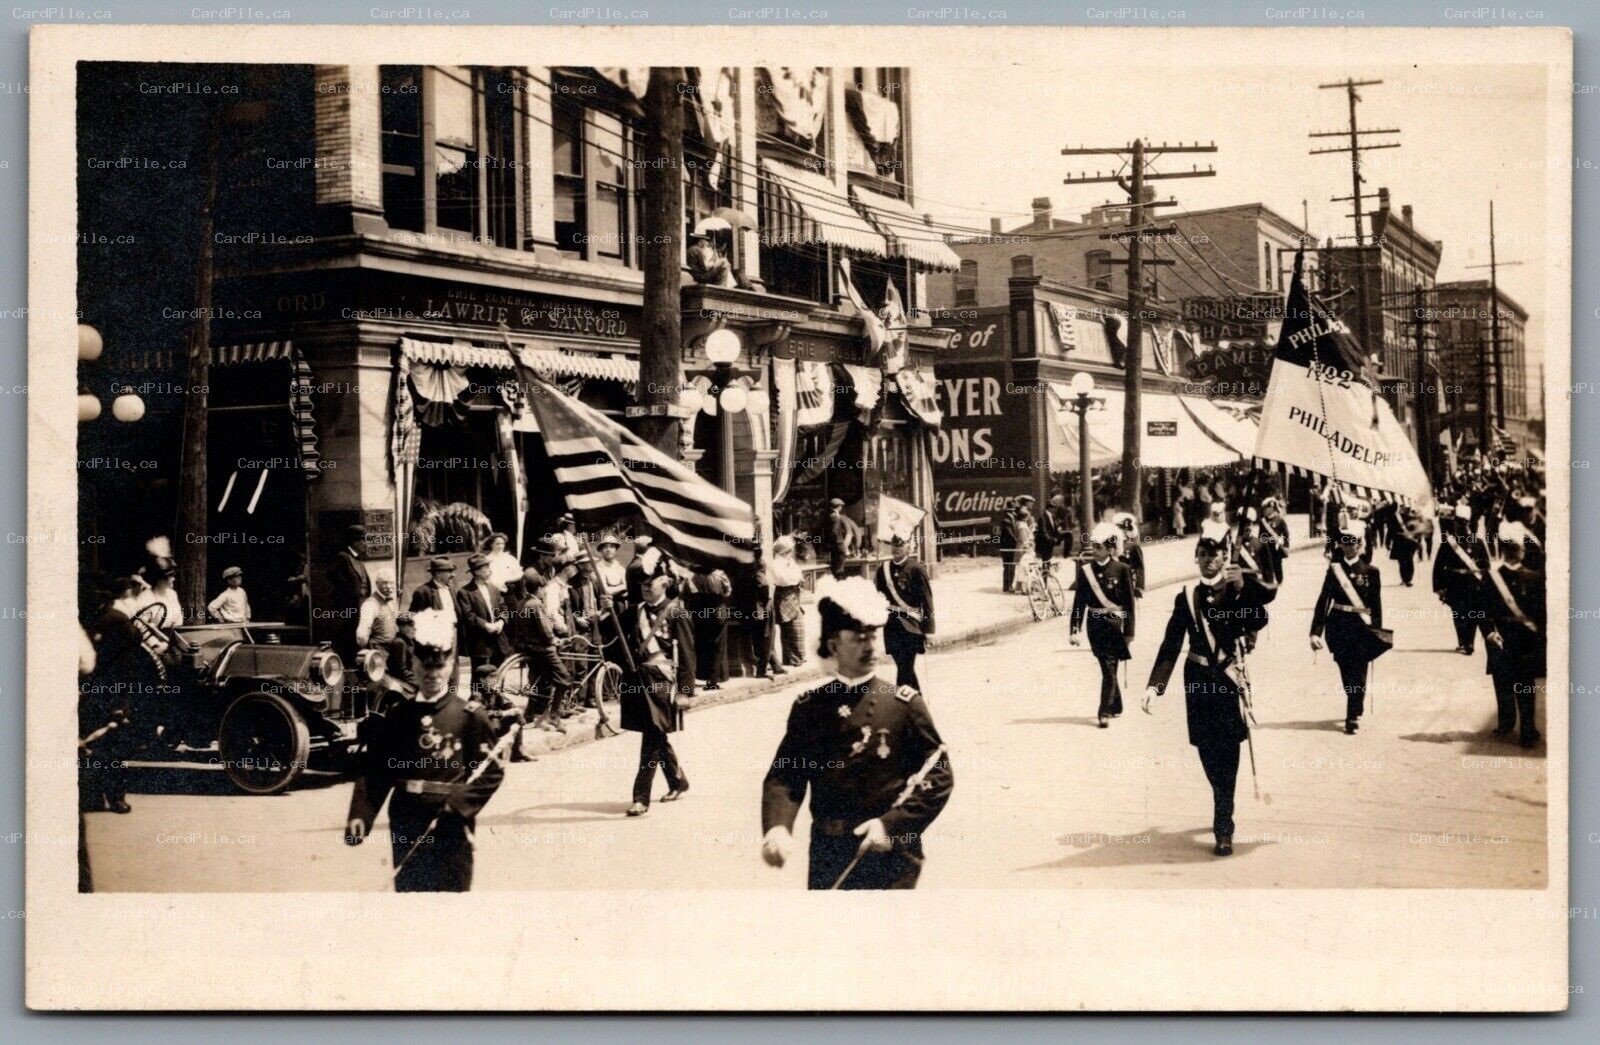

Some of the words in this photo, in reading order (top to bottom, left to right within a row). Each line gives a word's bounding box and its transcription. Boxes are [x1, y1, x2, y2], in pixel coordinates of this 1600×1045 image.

[425, 300, 509, 324] LAWRIE
[521, 309, 535, 327] &
[548, 312, 628, 336] SANFORD
[788, 339, 816, 357] ERIE
[968, 323, 998, 348] of
